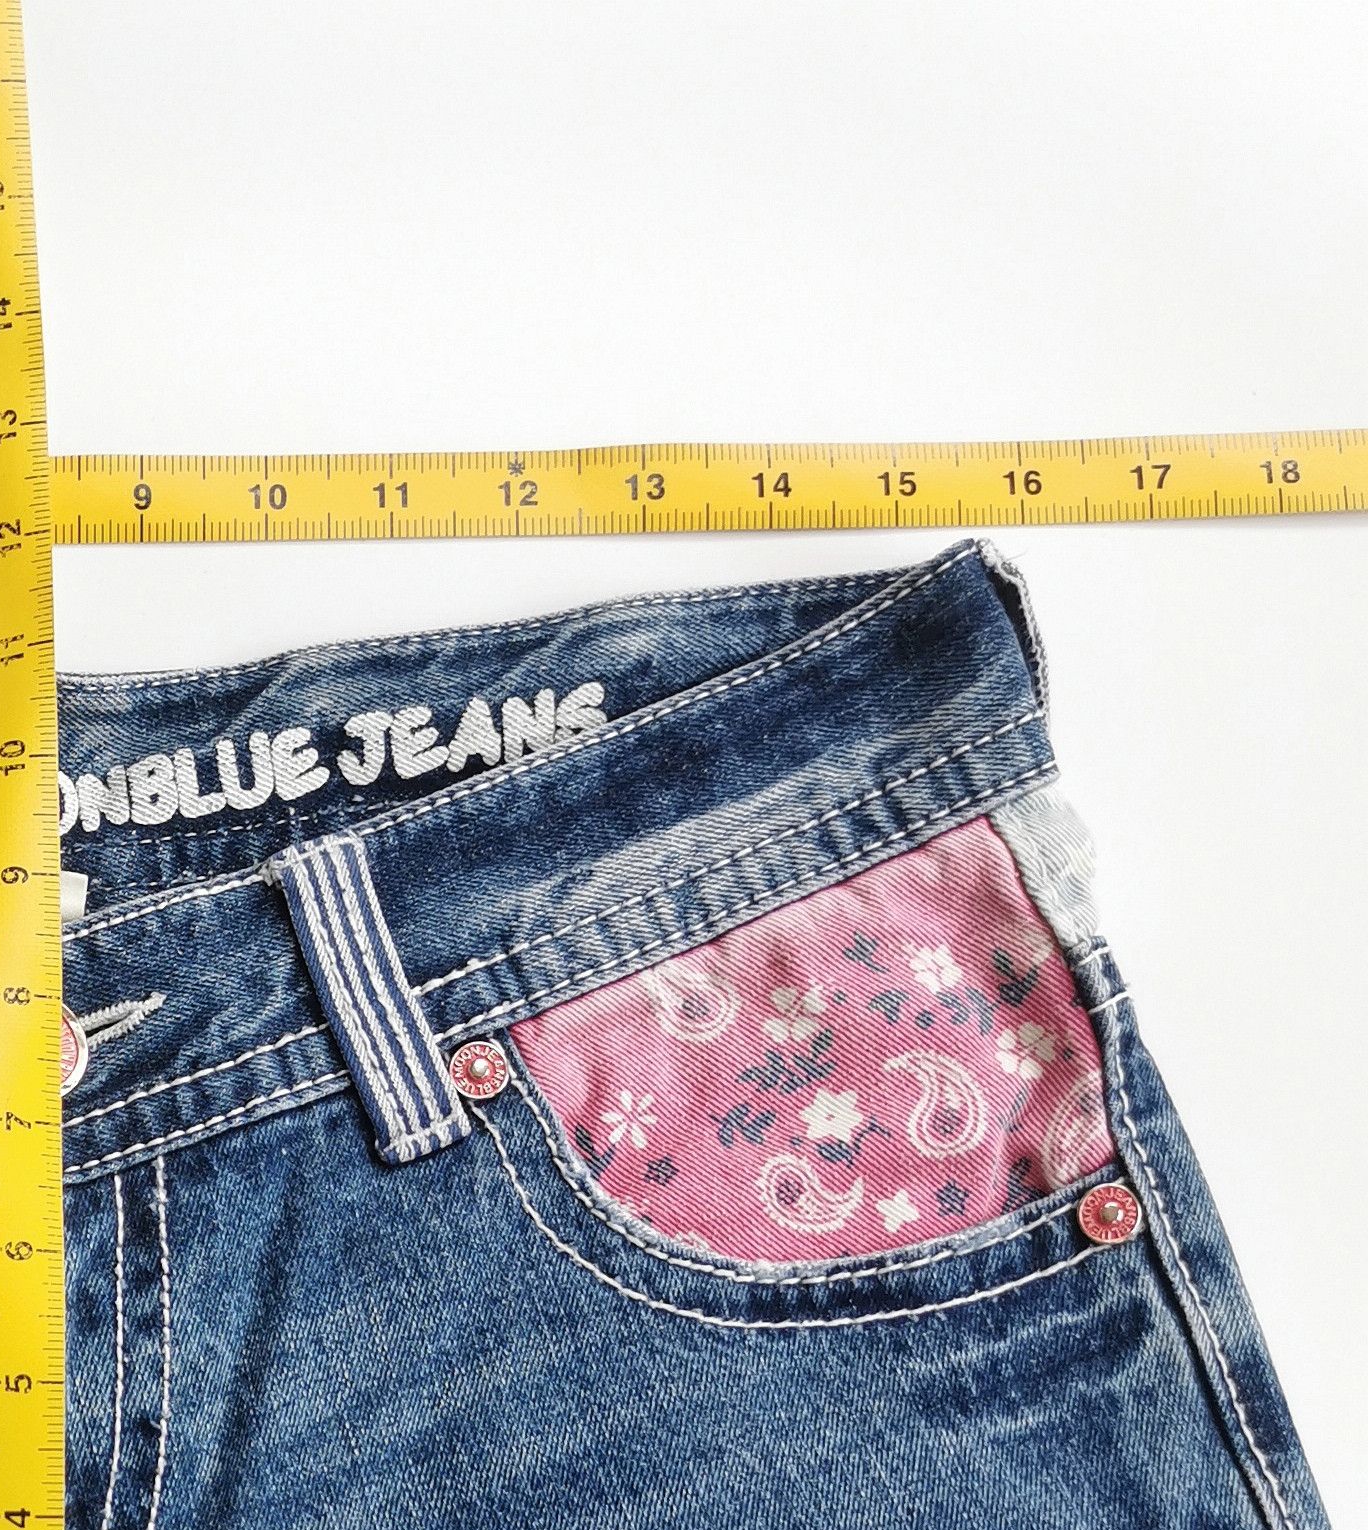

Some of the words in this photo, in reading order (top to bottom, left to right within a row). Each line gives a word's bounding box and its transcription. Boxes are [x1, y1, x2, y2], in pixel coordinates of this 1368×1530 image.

[133, 483, 152, 511] 9
[249, 483, 288, 510] 10
[372, 481, 408, 509] 11
[497, 480, 539, 507] 12
[625, 473, 666, 501] 13
[751, 472, 793, 498] 14
[877, 471, 917, 497] 15
[1002, 470, 1042, 496] 16
[1130, 464, 1172, 490] 17
[1259, 460, 1301, 484] 18
[0, 633, 25, 666] 11
[336, 681, 608, 787] JEANS
[0, 866, 29, 885] 9
[3, 986, 31, 1006] 8
[5, 1111, 32, 1131] 7
[4, 1241, 33, 1261] 6
[4, 1374, 32, 1394] 5
[4, 1508, 31, 1529] 4
